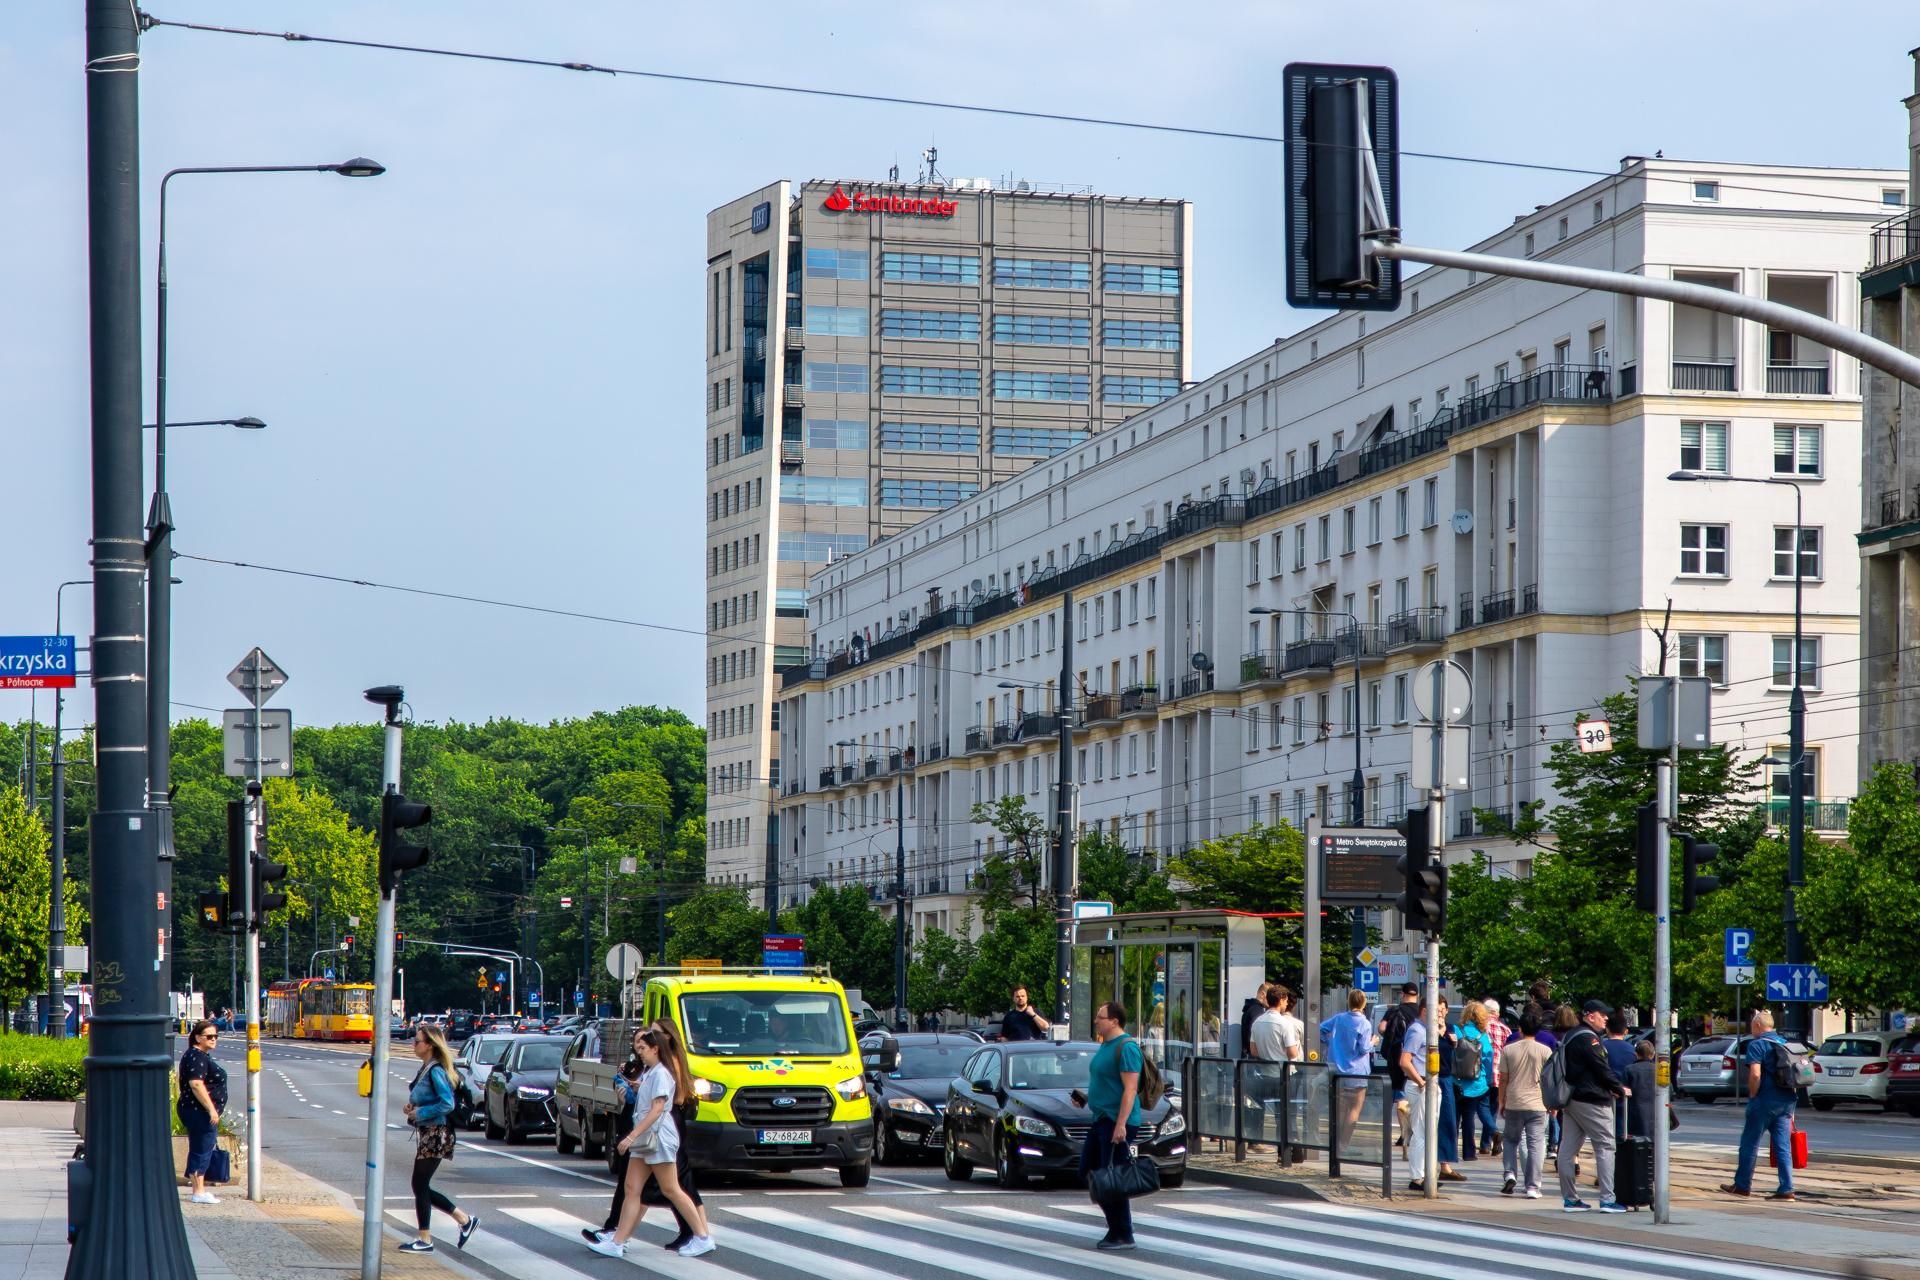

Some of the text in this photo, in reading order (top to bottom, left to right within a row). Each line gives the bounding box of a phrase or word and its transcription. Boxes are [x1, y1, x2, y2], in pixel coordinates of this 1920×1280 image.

[853, 191, 959, 217] Santander
[43, 638, 67, 647] 32-30
[7, 677, 44, 687] Północne
[1585, 729, 1605, 744] 30
[1336, 838, 1354, 846] Metro
[1355, 836, 1398, 848] Świętokrzyska
